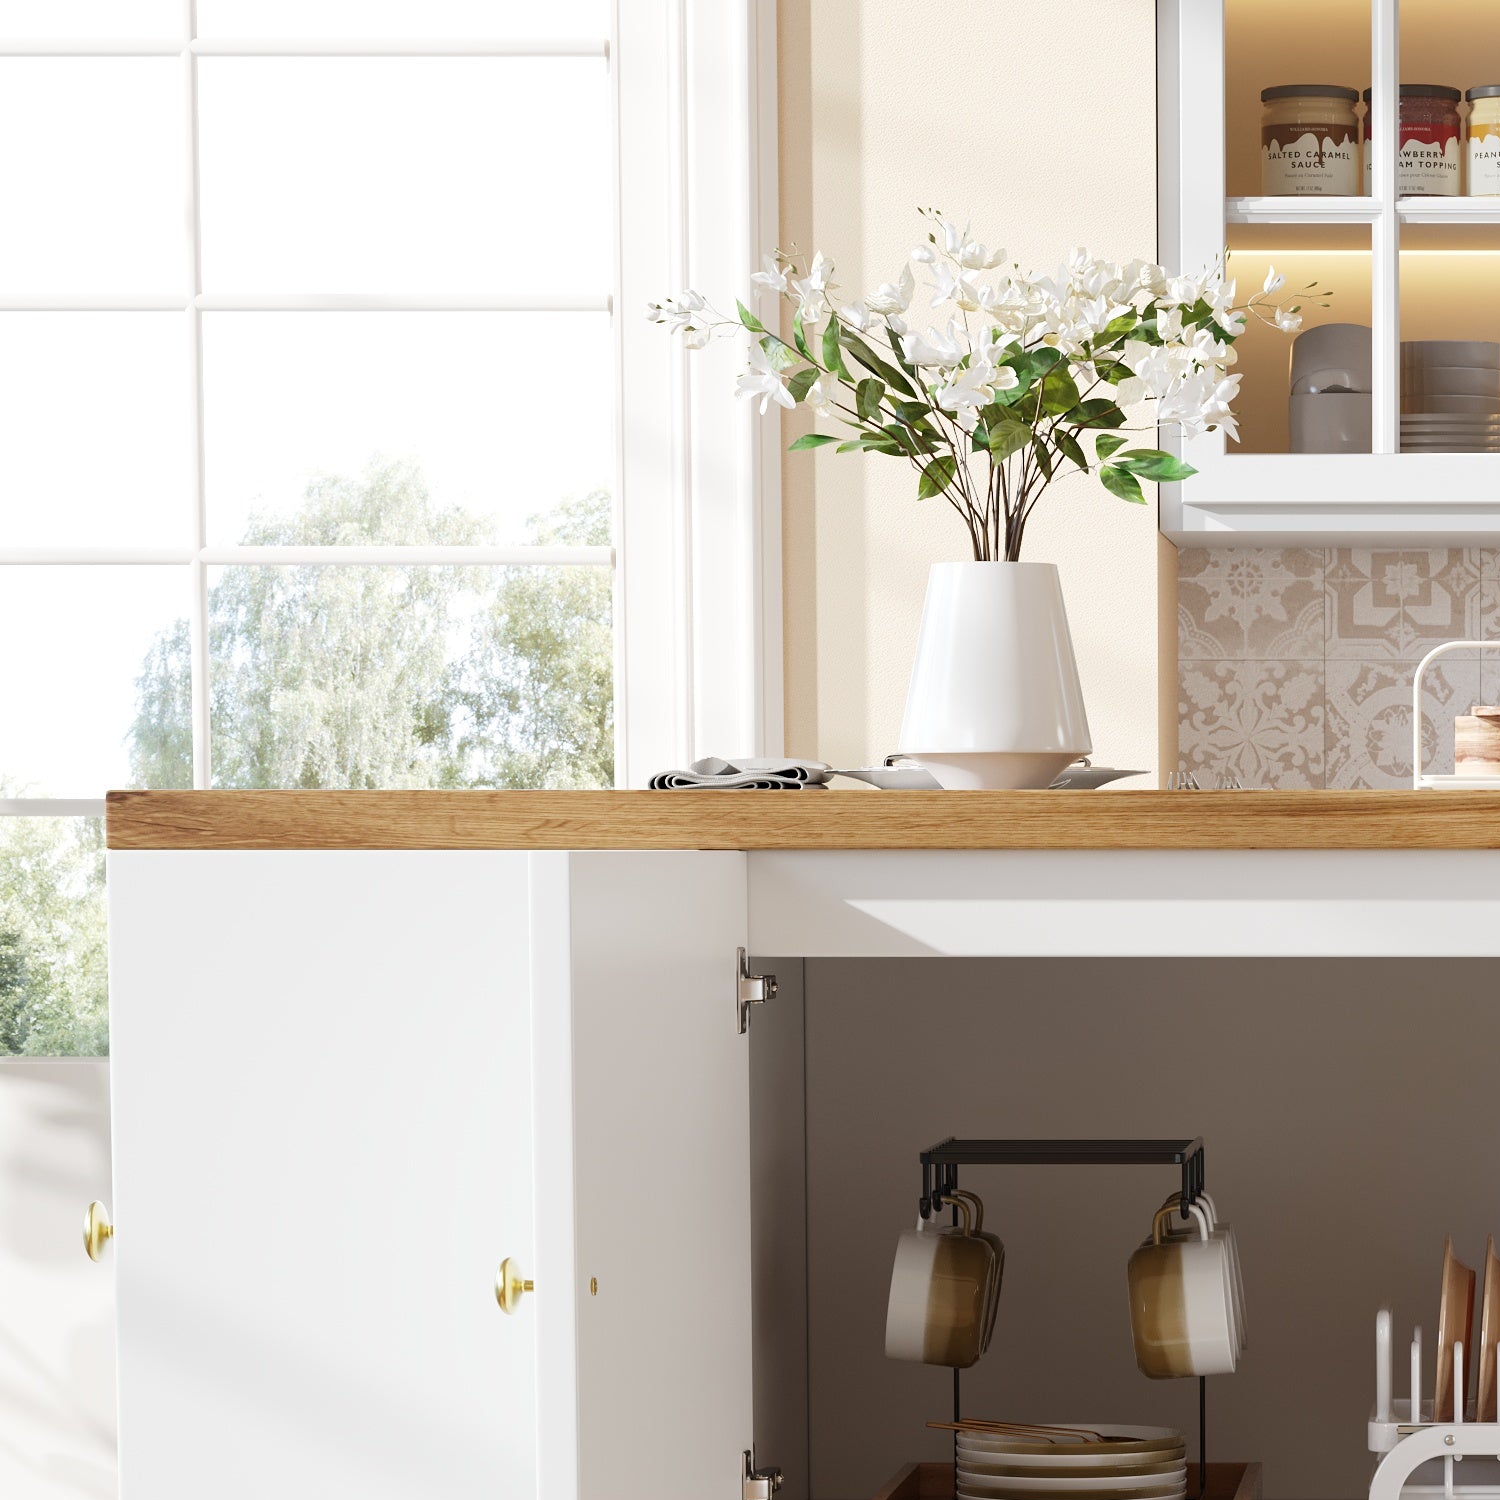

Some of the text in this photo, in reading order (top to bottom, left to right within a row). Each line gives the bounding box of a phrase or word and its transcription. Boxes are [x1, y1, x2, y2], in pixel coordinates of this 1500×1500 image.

[1268, 151, 1350, 160] SALTED CARAMEL
[1399, 150, 1443, 158] WBERRY
[1418, 161, 1457, 171] TOPPING
